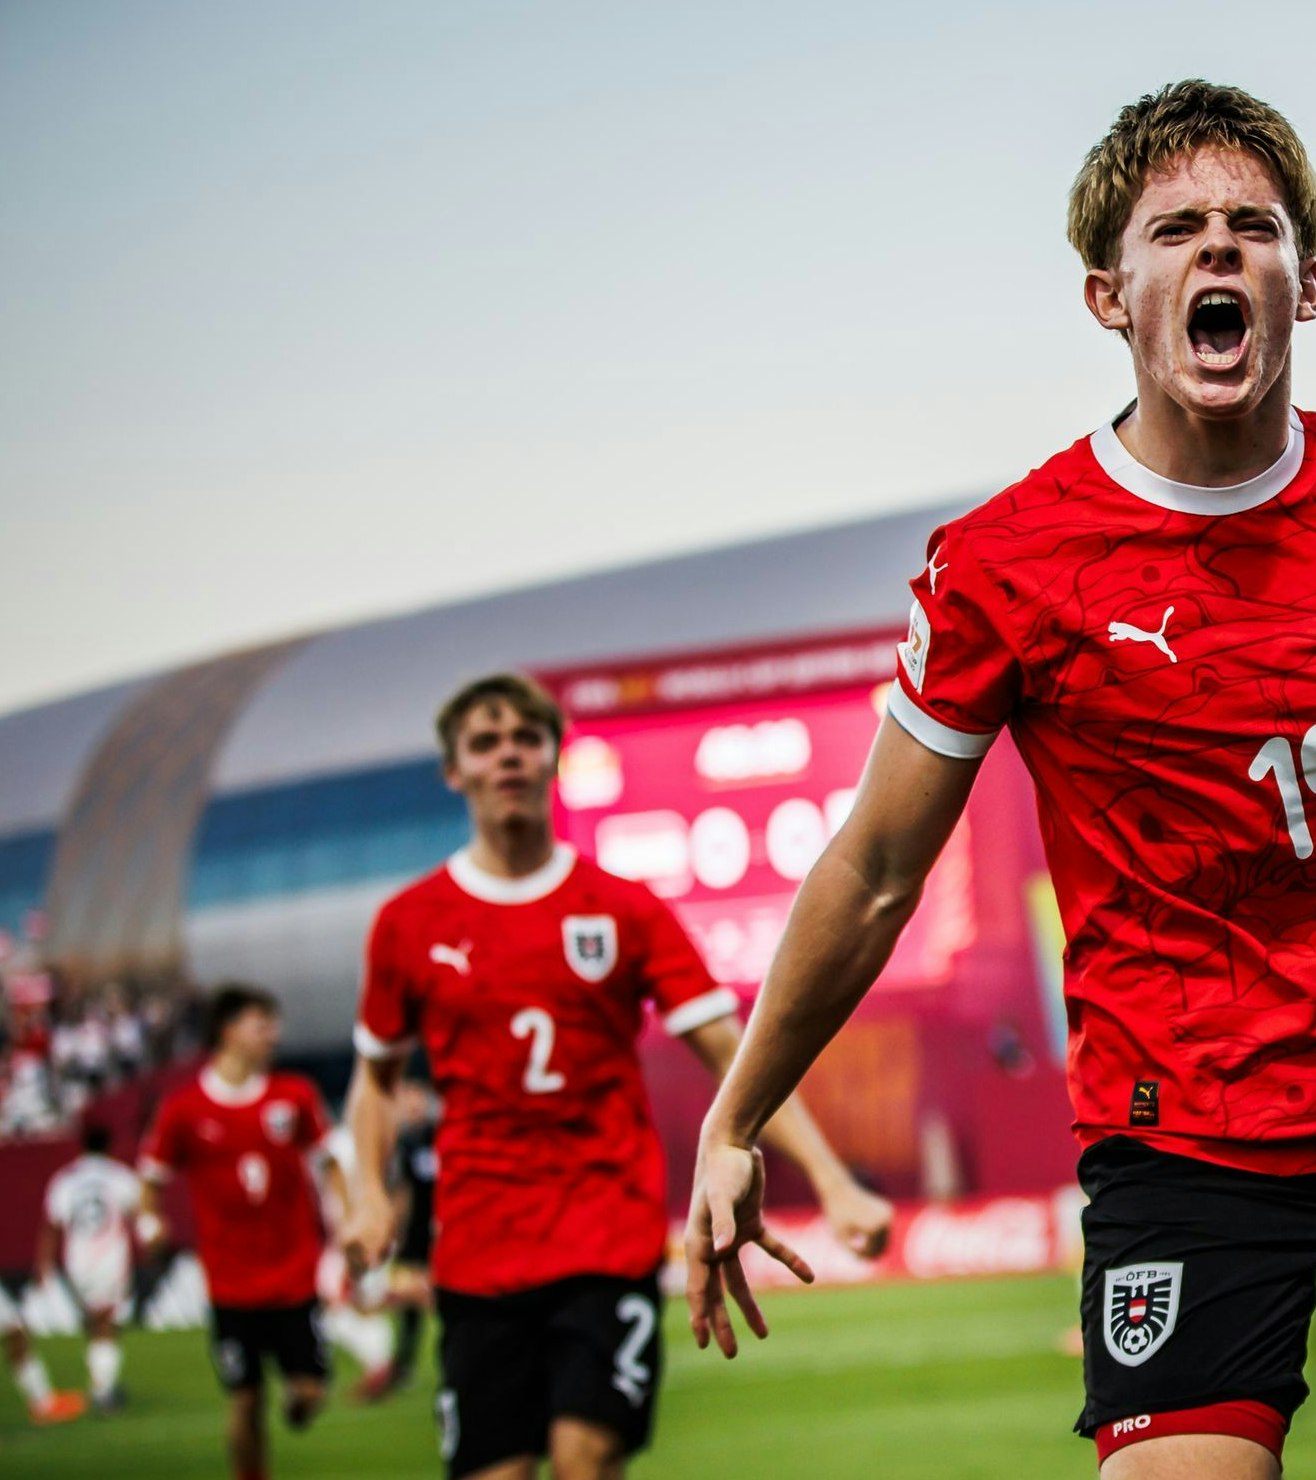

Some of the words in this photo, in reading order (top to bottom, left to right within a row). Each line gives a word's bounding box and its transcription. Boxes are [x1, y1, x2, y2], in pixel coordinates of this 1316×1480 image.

[509, 1005, 567, 1095] 2
[1126, 1269, 1157, 1282] ÖFB
[615, 1293, 656, 1384] 2
[1112, 1414, 1152, 1438] PRO
